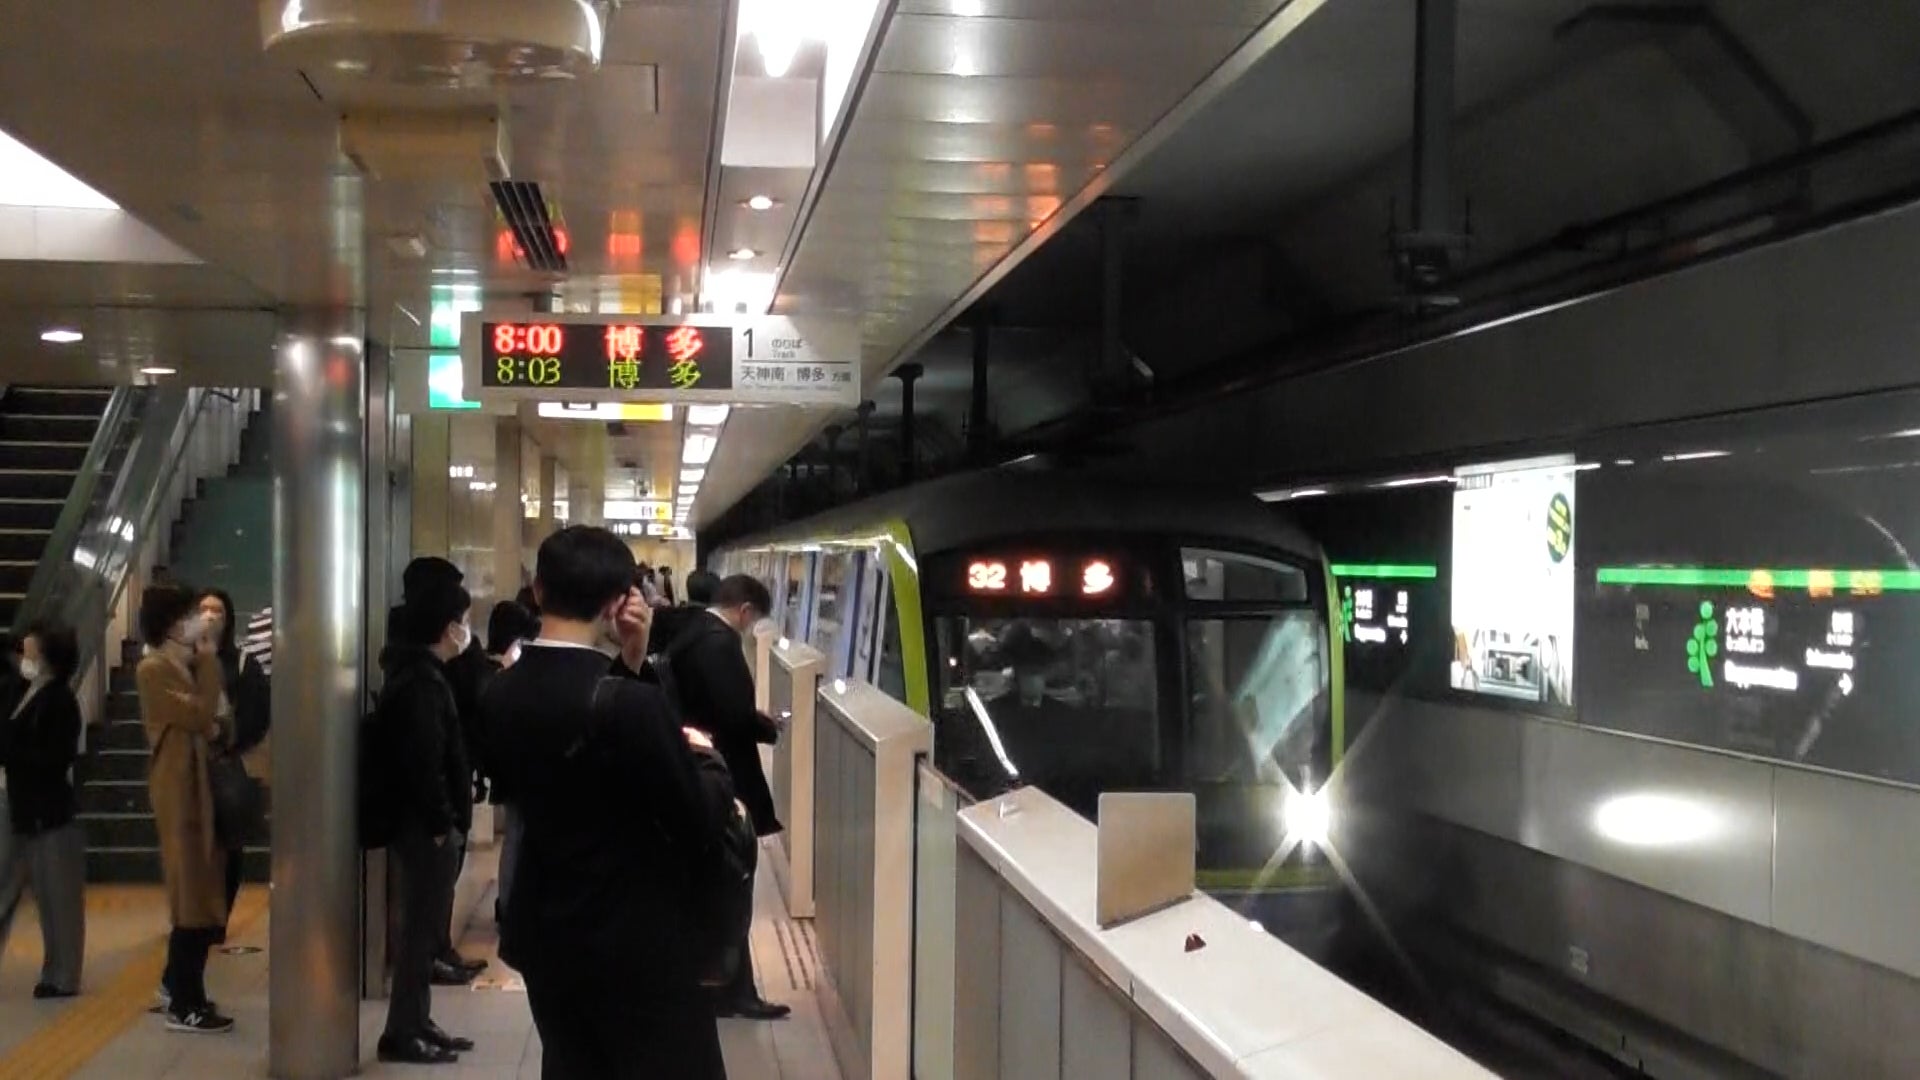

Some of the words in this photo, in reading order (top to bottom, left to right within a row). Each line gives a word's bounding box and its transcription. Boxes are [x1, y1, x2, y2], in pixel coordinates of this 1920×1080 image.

[495, 324, 562, 354] 8:00
[743, 328, 753, 358] 1
[497, 356, 561, 385] 8:03
[968, 562, 1007, 589] 32
